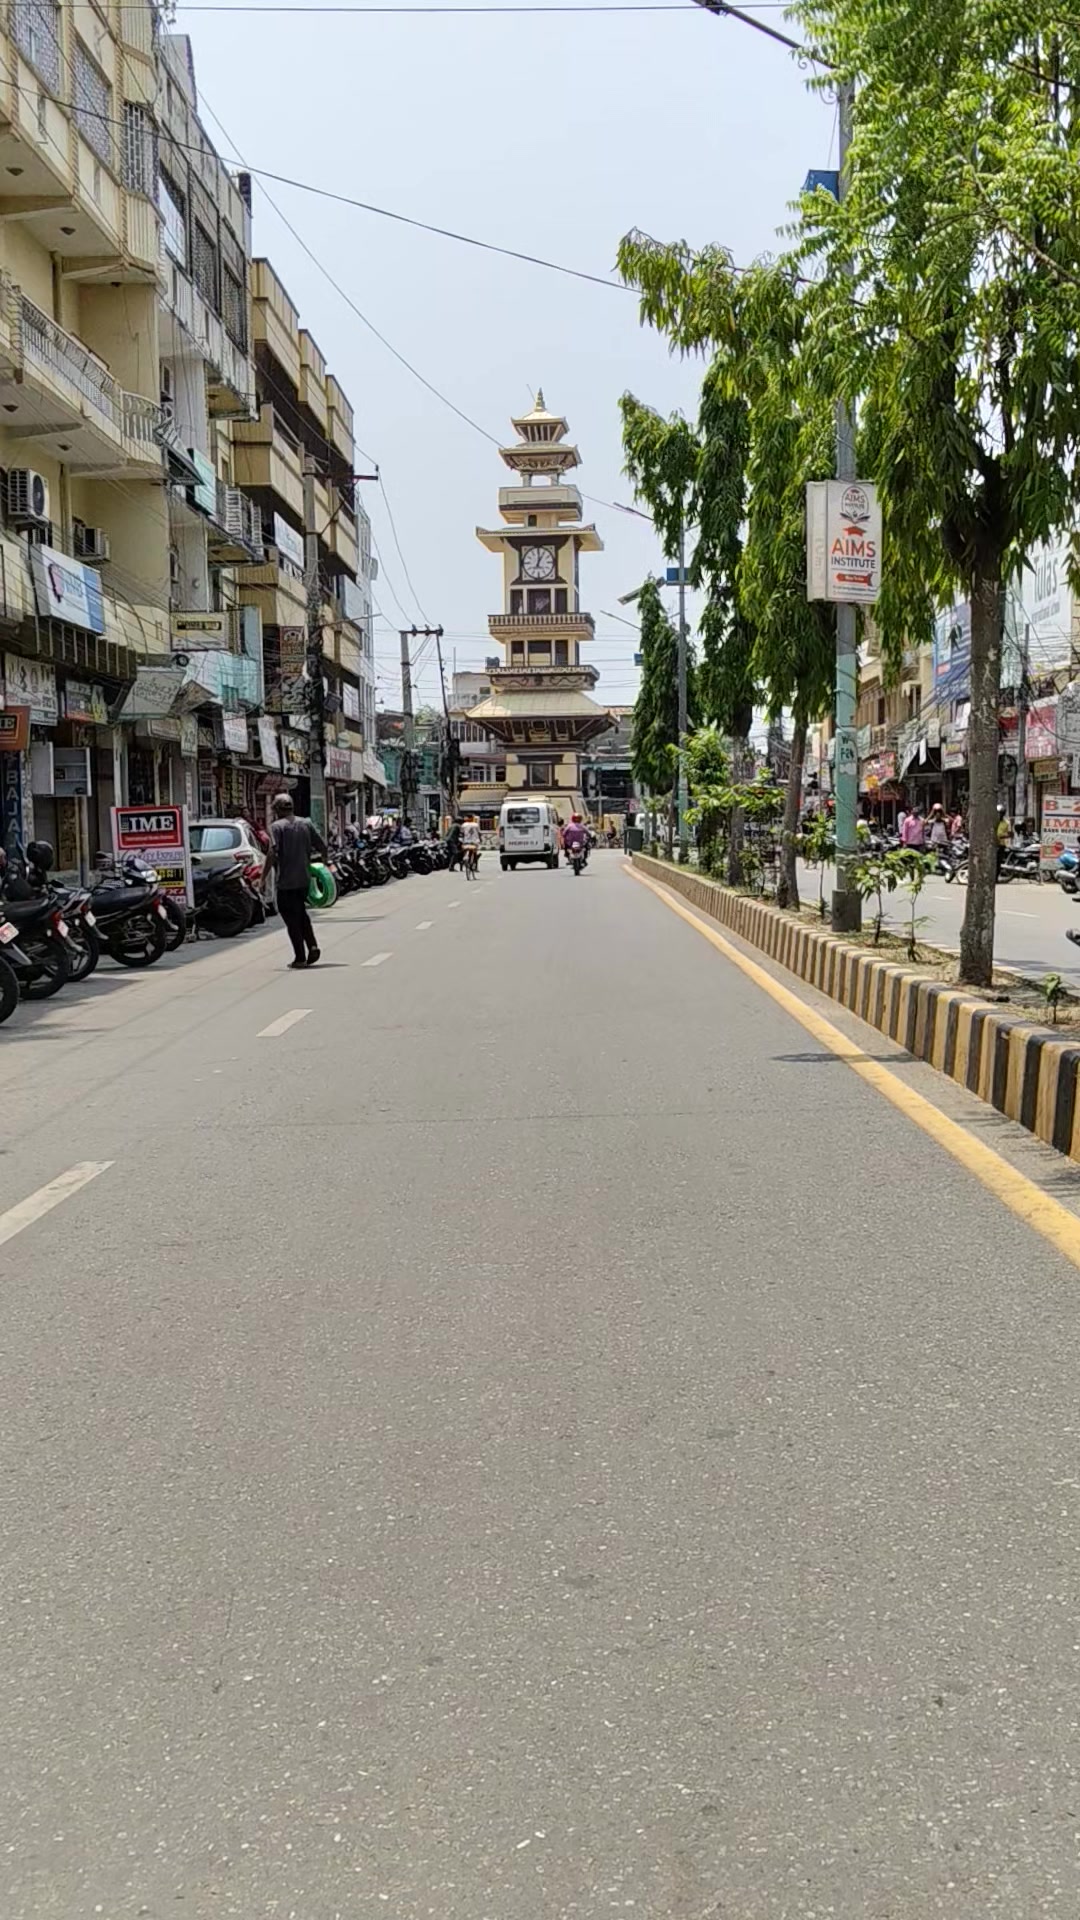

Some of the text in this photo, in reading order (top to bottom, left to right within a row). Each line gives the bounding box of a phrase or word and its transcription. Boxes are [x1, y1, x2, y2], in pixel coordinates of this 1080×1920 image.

[832, 538, 876, 557] AIMS
[831, 557, 876, 568] INSTITUTE
[129, 816, 174, 832] IME
